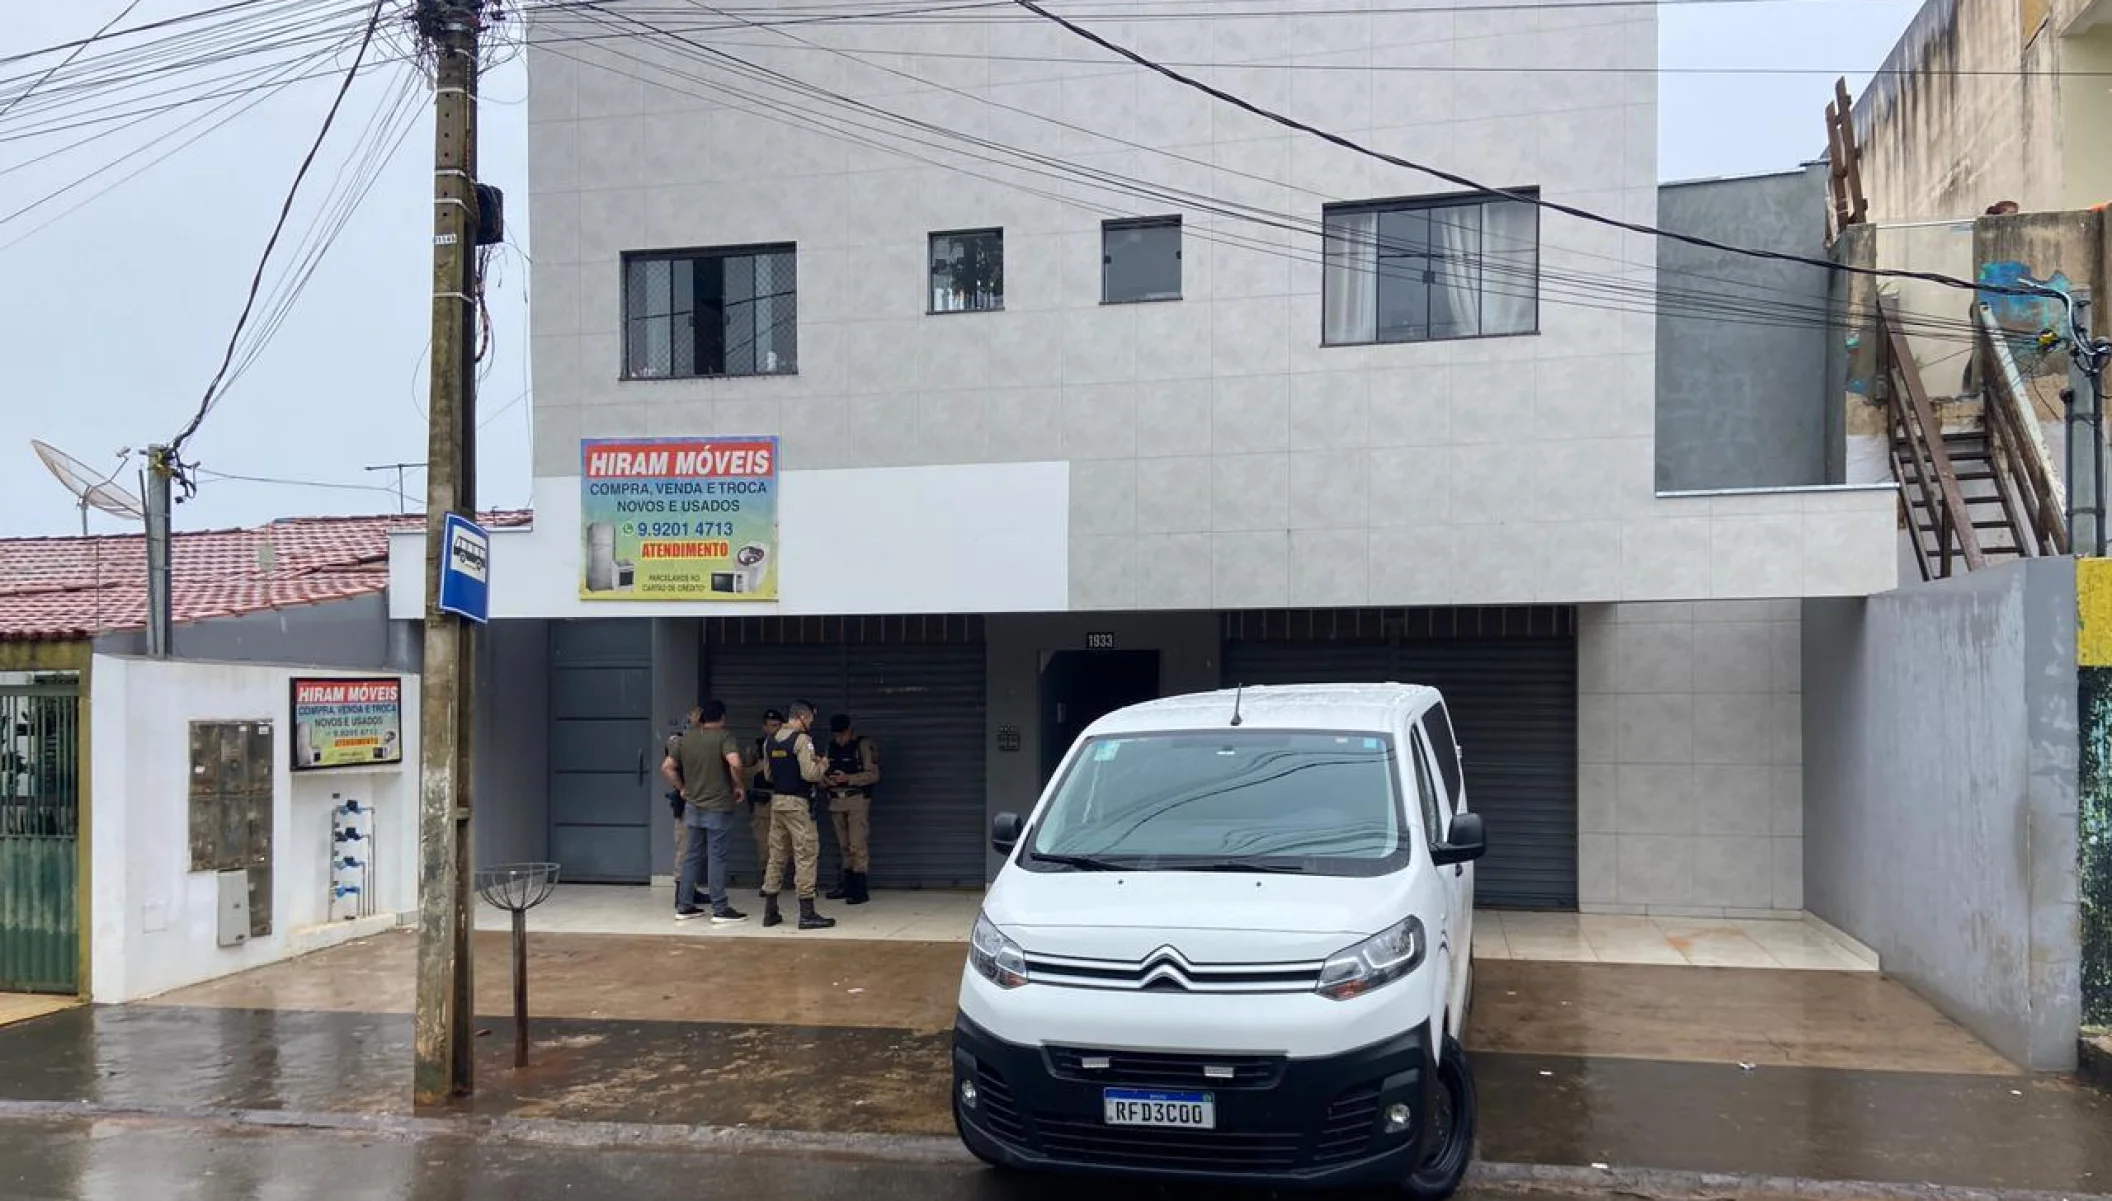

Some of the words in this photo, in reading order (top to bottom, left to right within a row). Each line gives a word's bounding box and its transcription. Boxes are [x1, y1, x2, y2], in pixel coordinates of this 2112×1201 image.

[590, 451, 669, 476] HIRAM
[674, 445, 770, 475] MÓVEIS
[590, 482, 652, 496] COMPRA,
[655, 482, 702, 495] VENDA
[707, 482, 716, 494] E
[718, 481, 767, 494] TROCA
[616, 500, 665, 513] NOVOS
[669, 500, 678, 512] E
[682, 499, 740, 512] USADOS
[638, 522, 689, 537] 9.9201
[695, 522, 734, 537] 4713
[641, 541, 729, 559] ATENDIMENTO
[1088, 634, 1113, 648] 1933
[299, 686, 345, 702] HIRAM
[347, 683, 398, 701] MÓVEIS
[315, 717, 342, 727] NOVOS
[344, 716, 350, 727] E
[352, 715, 383, 726] USADOS
